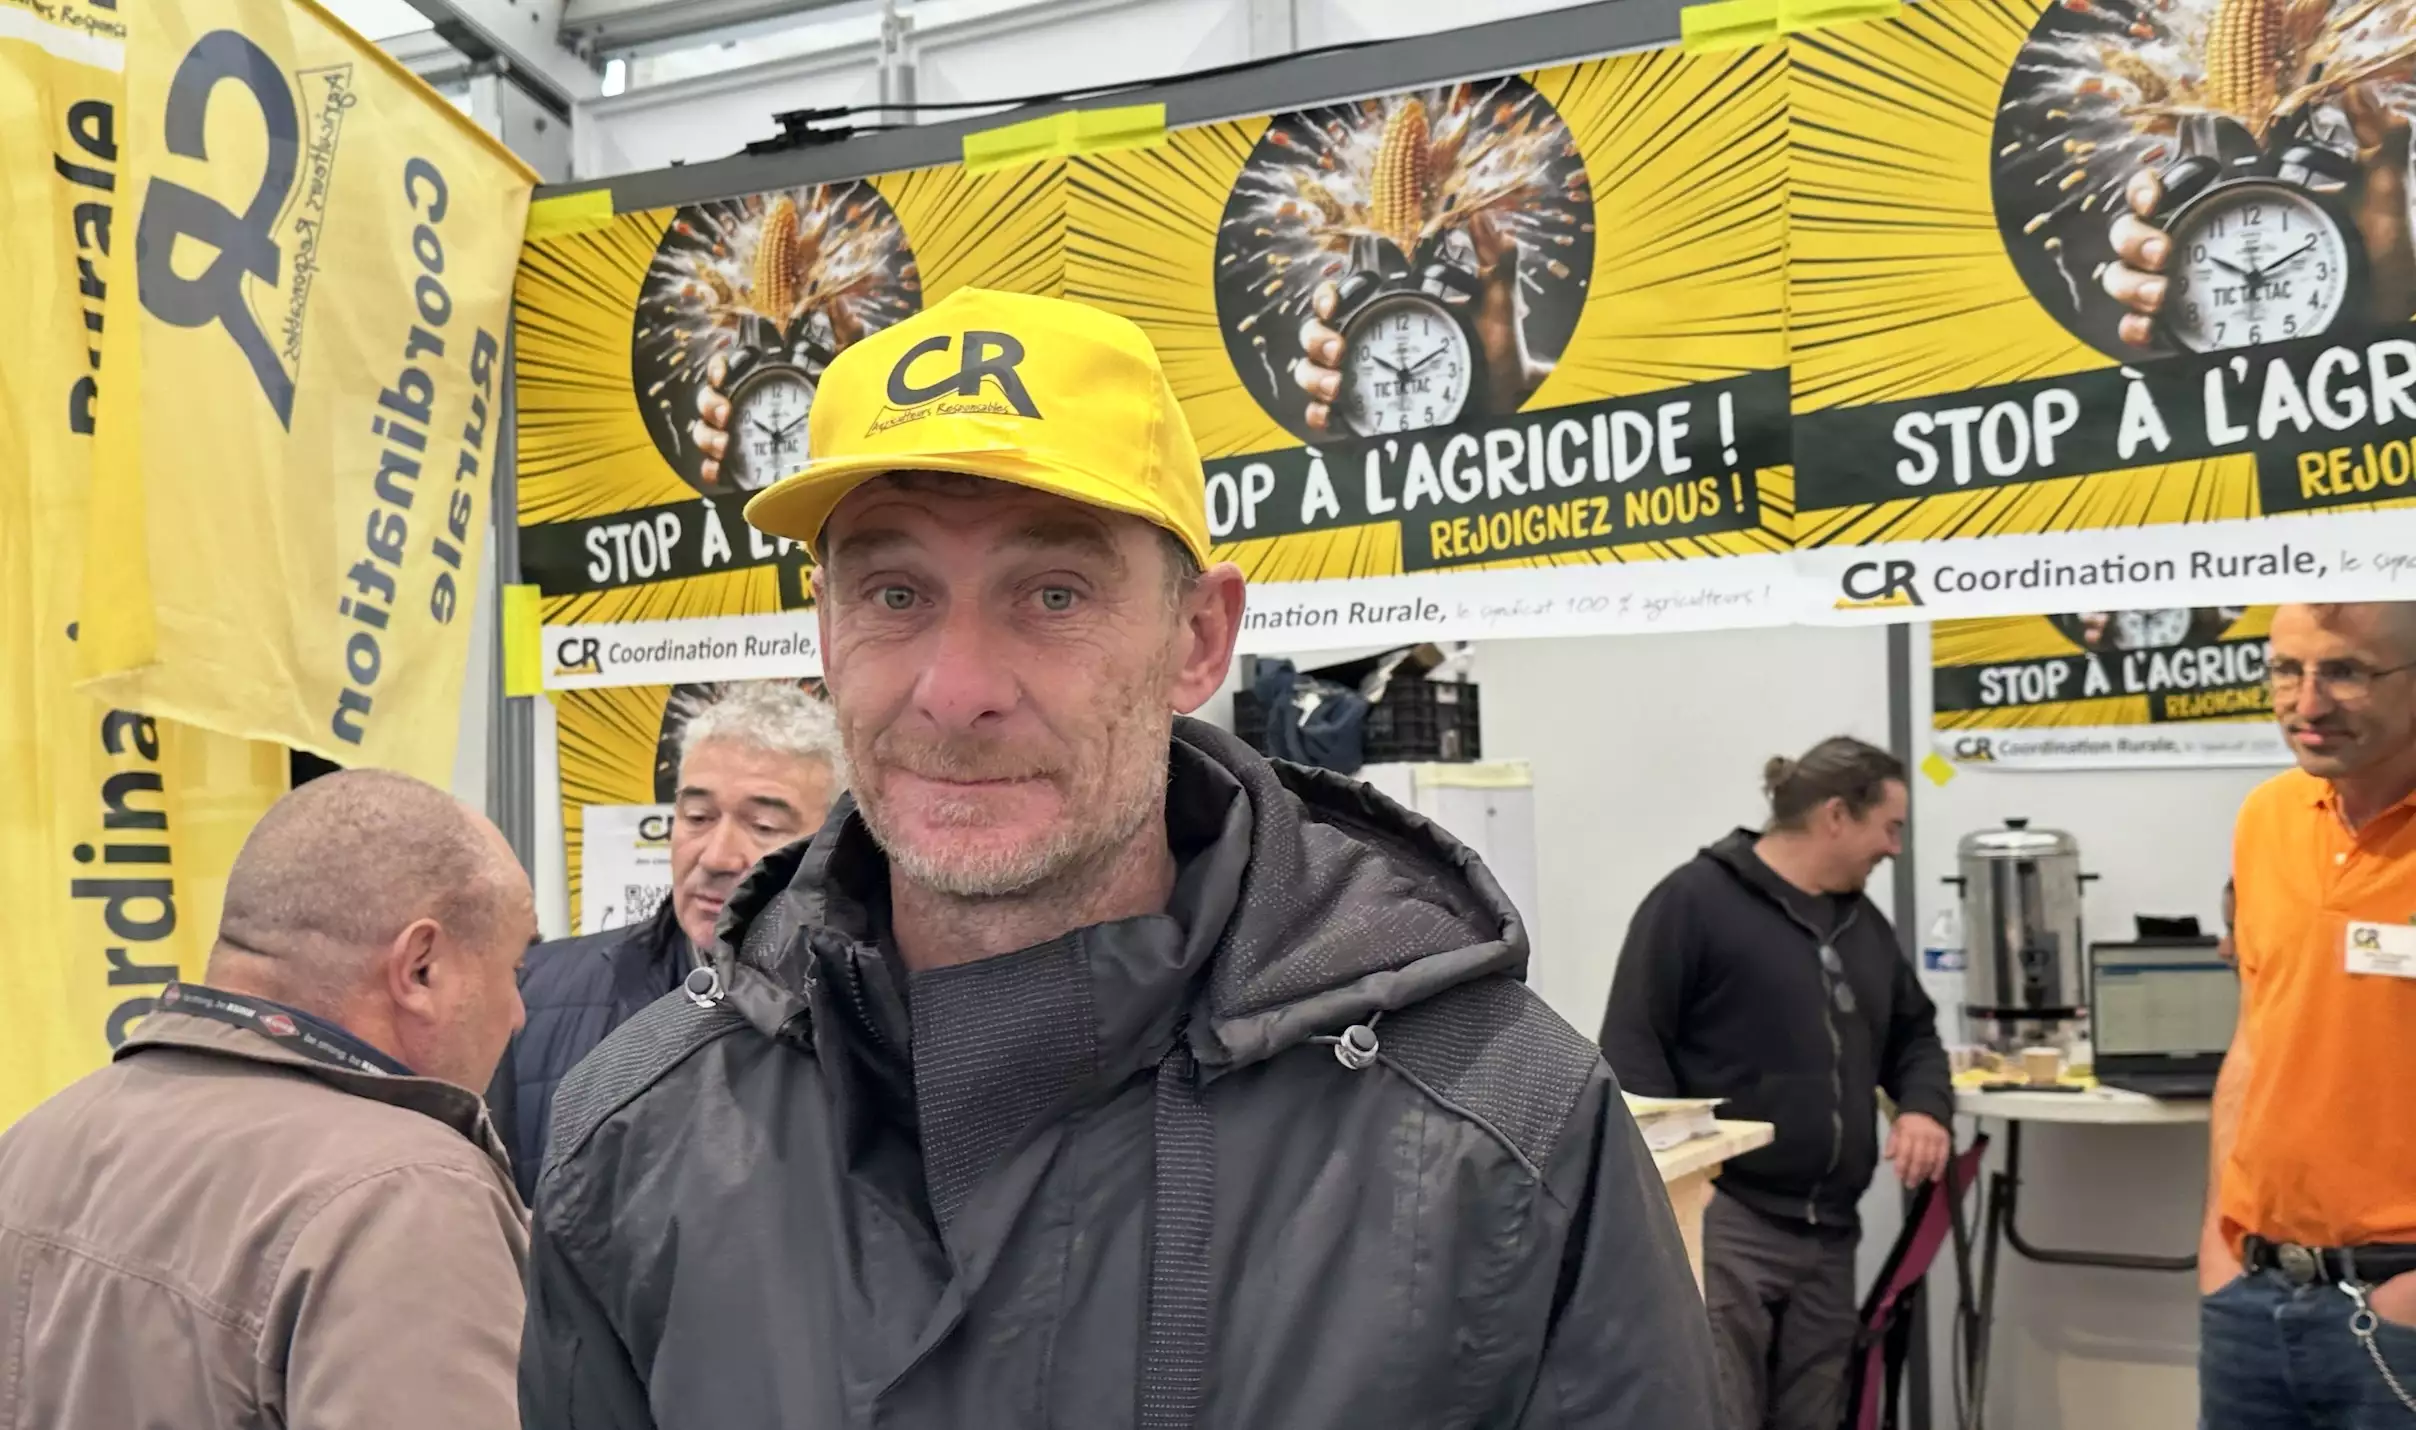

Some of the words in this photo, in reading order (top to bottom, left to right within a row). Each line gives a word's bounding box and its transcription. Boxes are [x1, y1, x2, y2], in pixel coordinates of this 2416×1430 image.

[2209, 217, 2224, 239] 11
[2241, 206, 2261, 226] 12
[2316, 262, 2327, 280] 3
[2215, 322, 2226, 343] 7
[2249, 325, 2261, 345] 6
[2283, 314, 2297, 333] 5
[886, 330, 1044, 420] CR
[1892, 388, 2080, 486] STOP
[2117, 365, 2172, 460] À
[1301, 446, 1341, 525] À
[1365, 401, 1692, 516] L'AGRICIDE
[1718, 391, 1738, 467] !
[1430, 496, 1613, 560] REJOIGNEZ
[1625, 476, 1721, 529] NOUS
[1732, 472, 1745, 513] !
[585, 512, 682, 584] STOP
[701, 497, 732, 568] À
[1841, 560, 1926, 606] CR
[1933, 556, 2175, 593] Coordination
[2191, 544, 2328, 579] Rurale,
[1349, 597, 1447, 625] Rurale,
[557, 637, 604, 674] CR
[608, 636, 738, 664] Coordination
[745, 632, 817, 658] Rurale,
[1979, 660, 2071, 705] STOP
